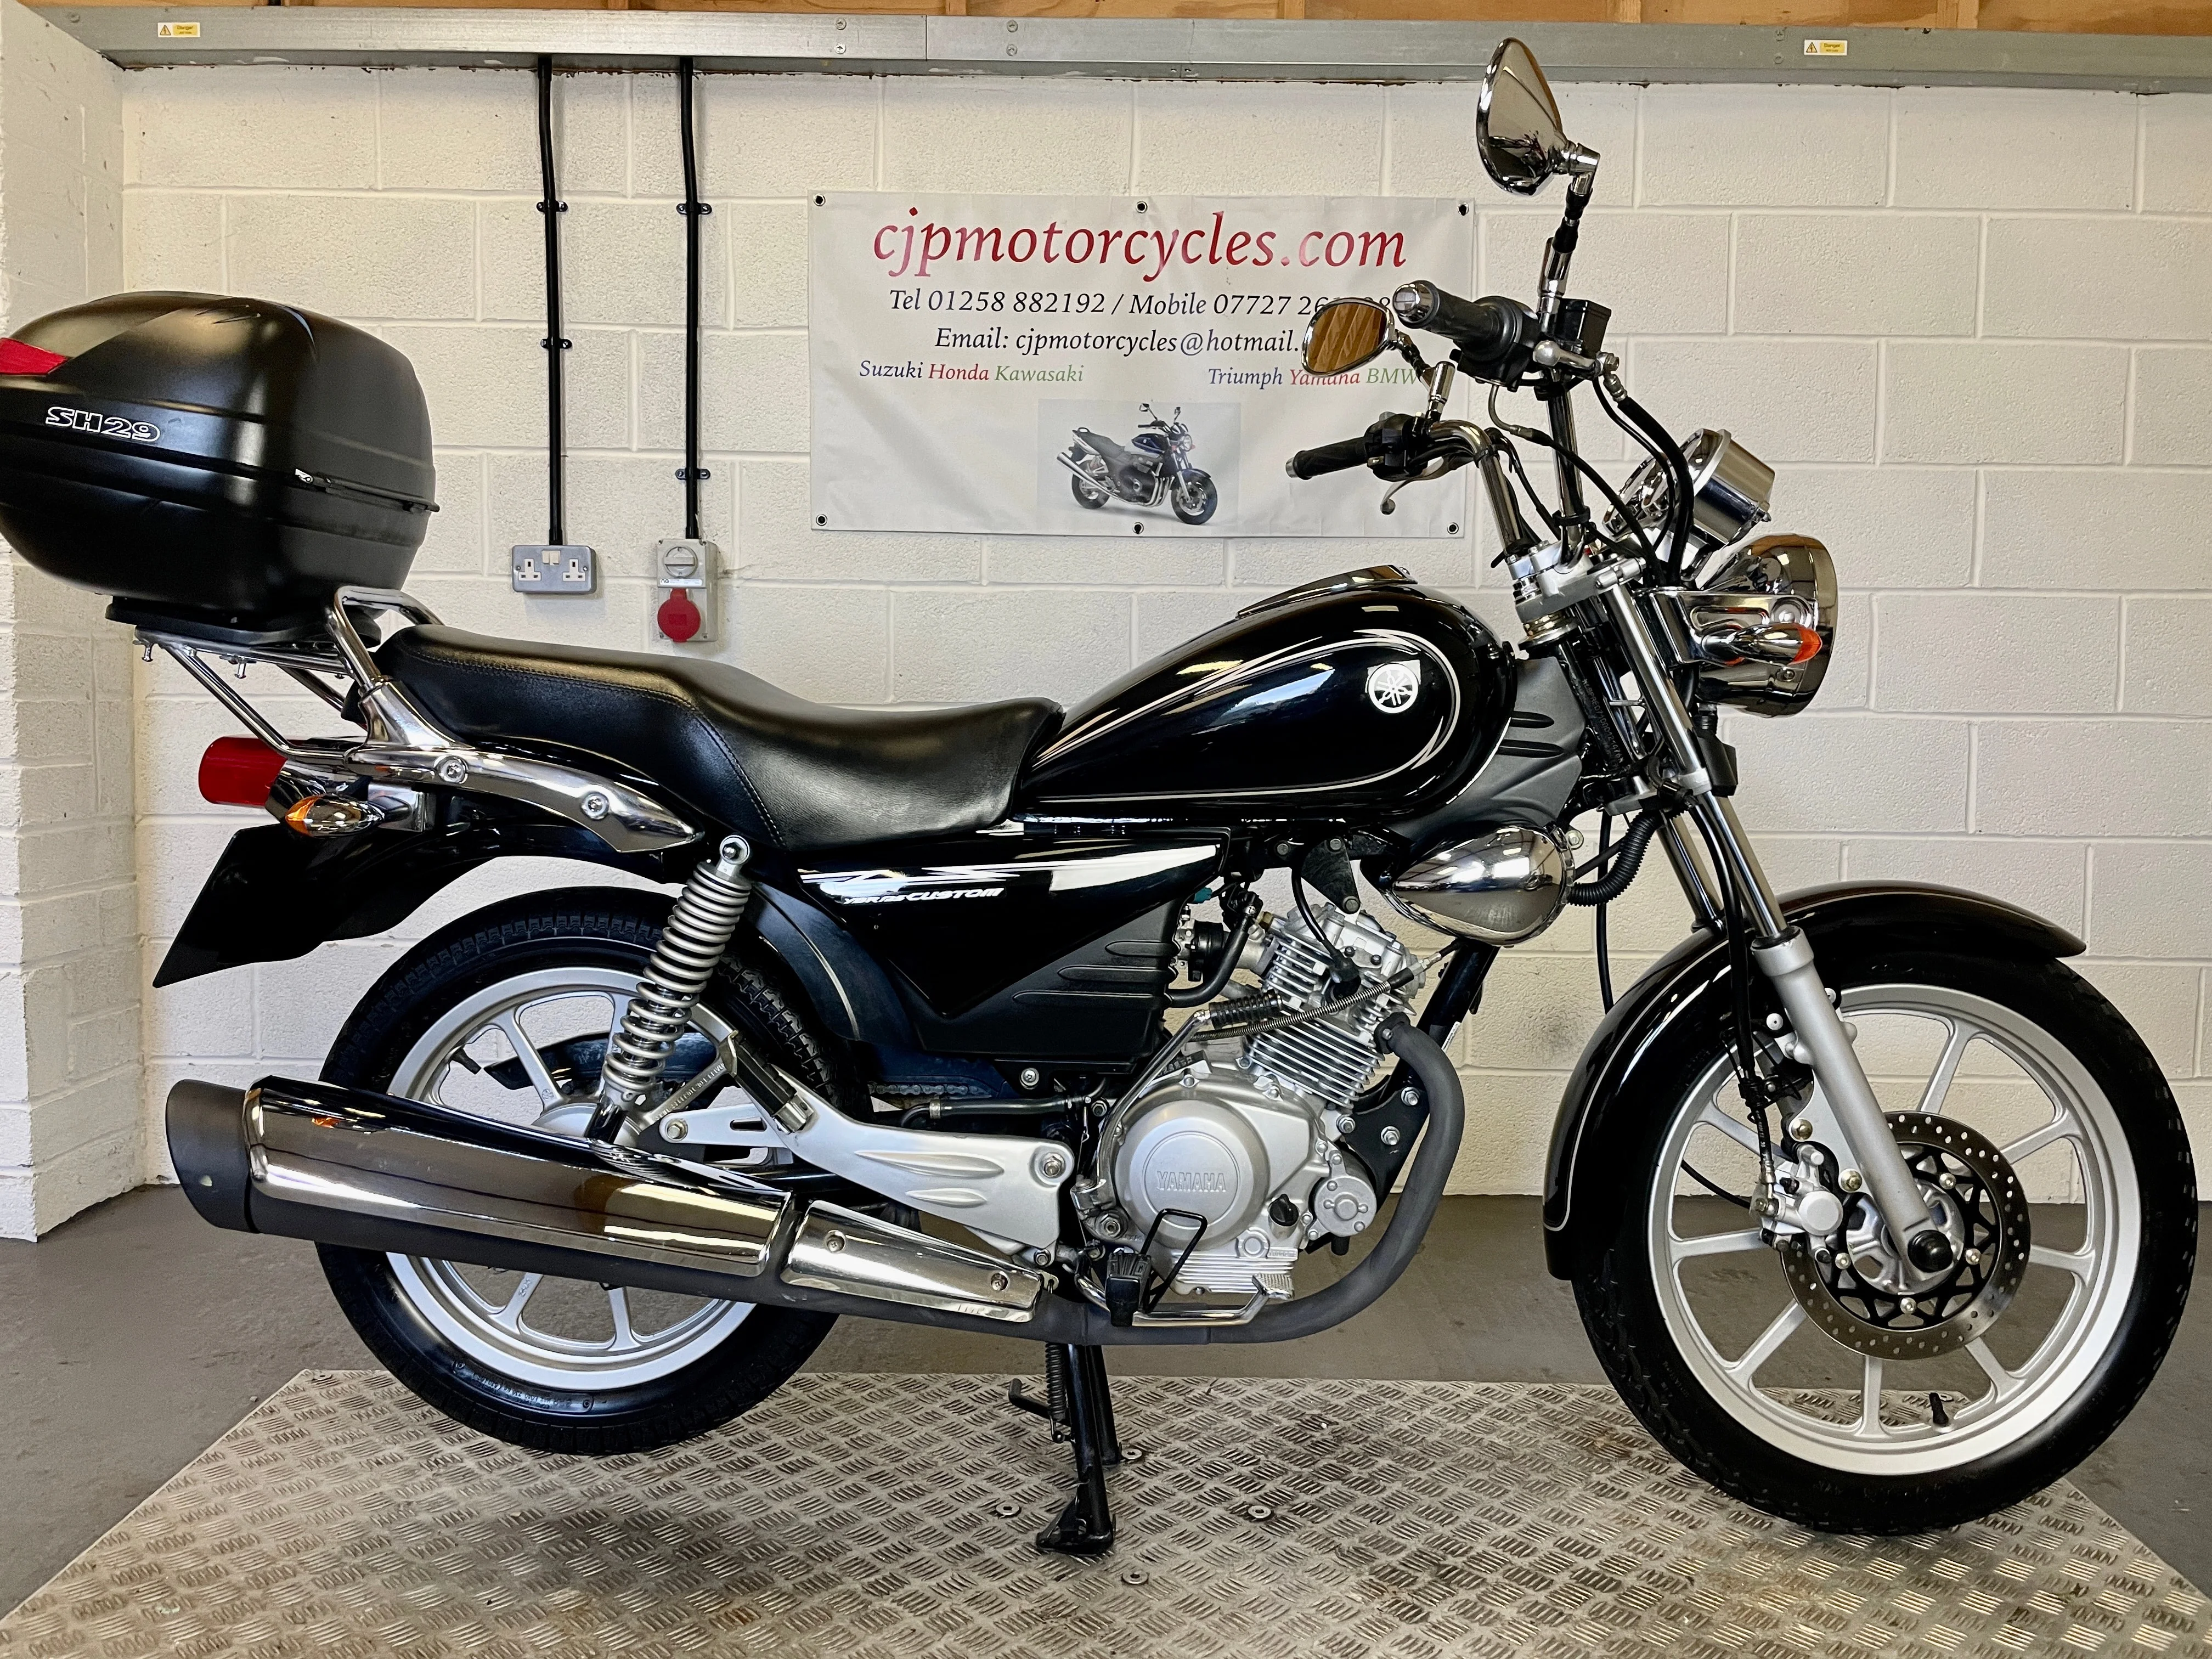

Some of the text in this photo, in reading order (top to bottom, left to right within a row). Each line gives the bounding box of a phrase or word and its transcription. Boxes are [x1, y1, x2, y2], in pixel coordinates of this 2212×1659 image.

[873, 207, 1407, 282] cjpmotorcycles.com
[890, 288, 921, 311] Tel
[929, 290, 1005, 312] 01258
[1013, 291, 1105, 313] 882192
[1111, 292, 1125, 314] /
[1128, 292, 1206, 315] Mobile
[1214, 294, 1292, 315] 07727
[934, 326, 1299, 357] Email: cjpmotorcycles@hotmail.
[859, 360, 1085, 383] Suzuki Honda Kawasaki
[1207, 366, 1283, 390] Triumph
[1366, 368, 1418, 385] BMW
[45, 406, 161, 442] SH29
[906, 888, 1005, 901] CUSTOM
[1156, 1171, 1227, 1193] YAMAHA
